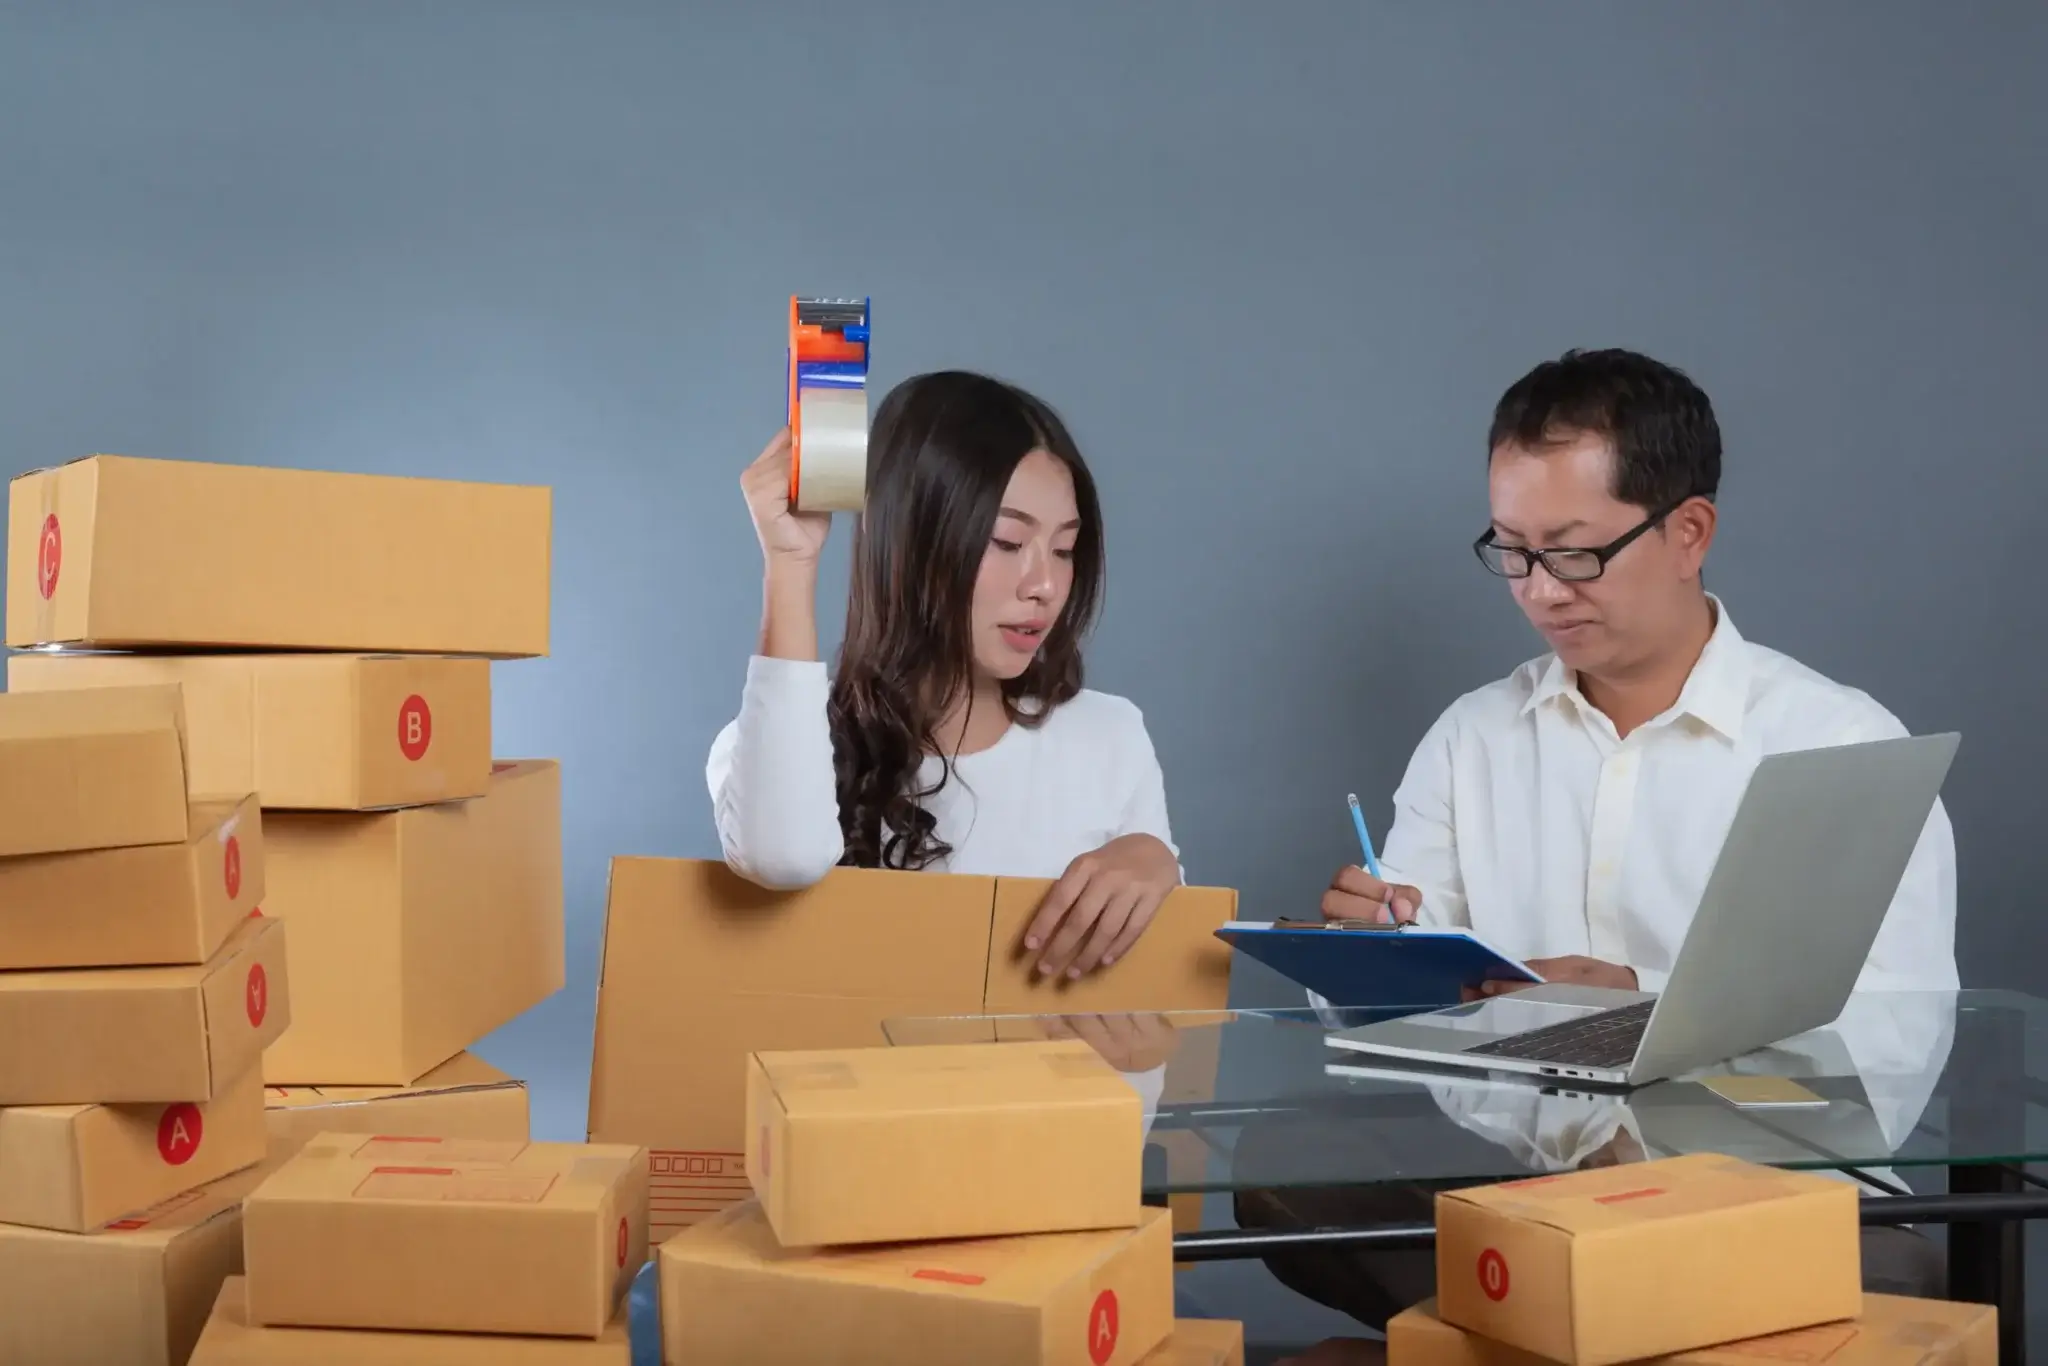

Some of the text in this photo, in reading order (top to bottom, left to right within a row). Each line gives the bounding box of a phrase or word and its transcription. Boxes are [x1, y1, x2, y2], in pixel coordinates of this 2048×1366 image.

[43, 531, 56, 580] C
[407, 711, 422, 744] B
[169, 1116, 190, 1151] A
[1096, 1308, 1112, 1349] A
